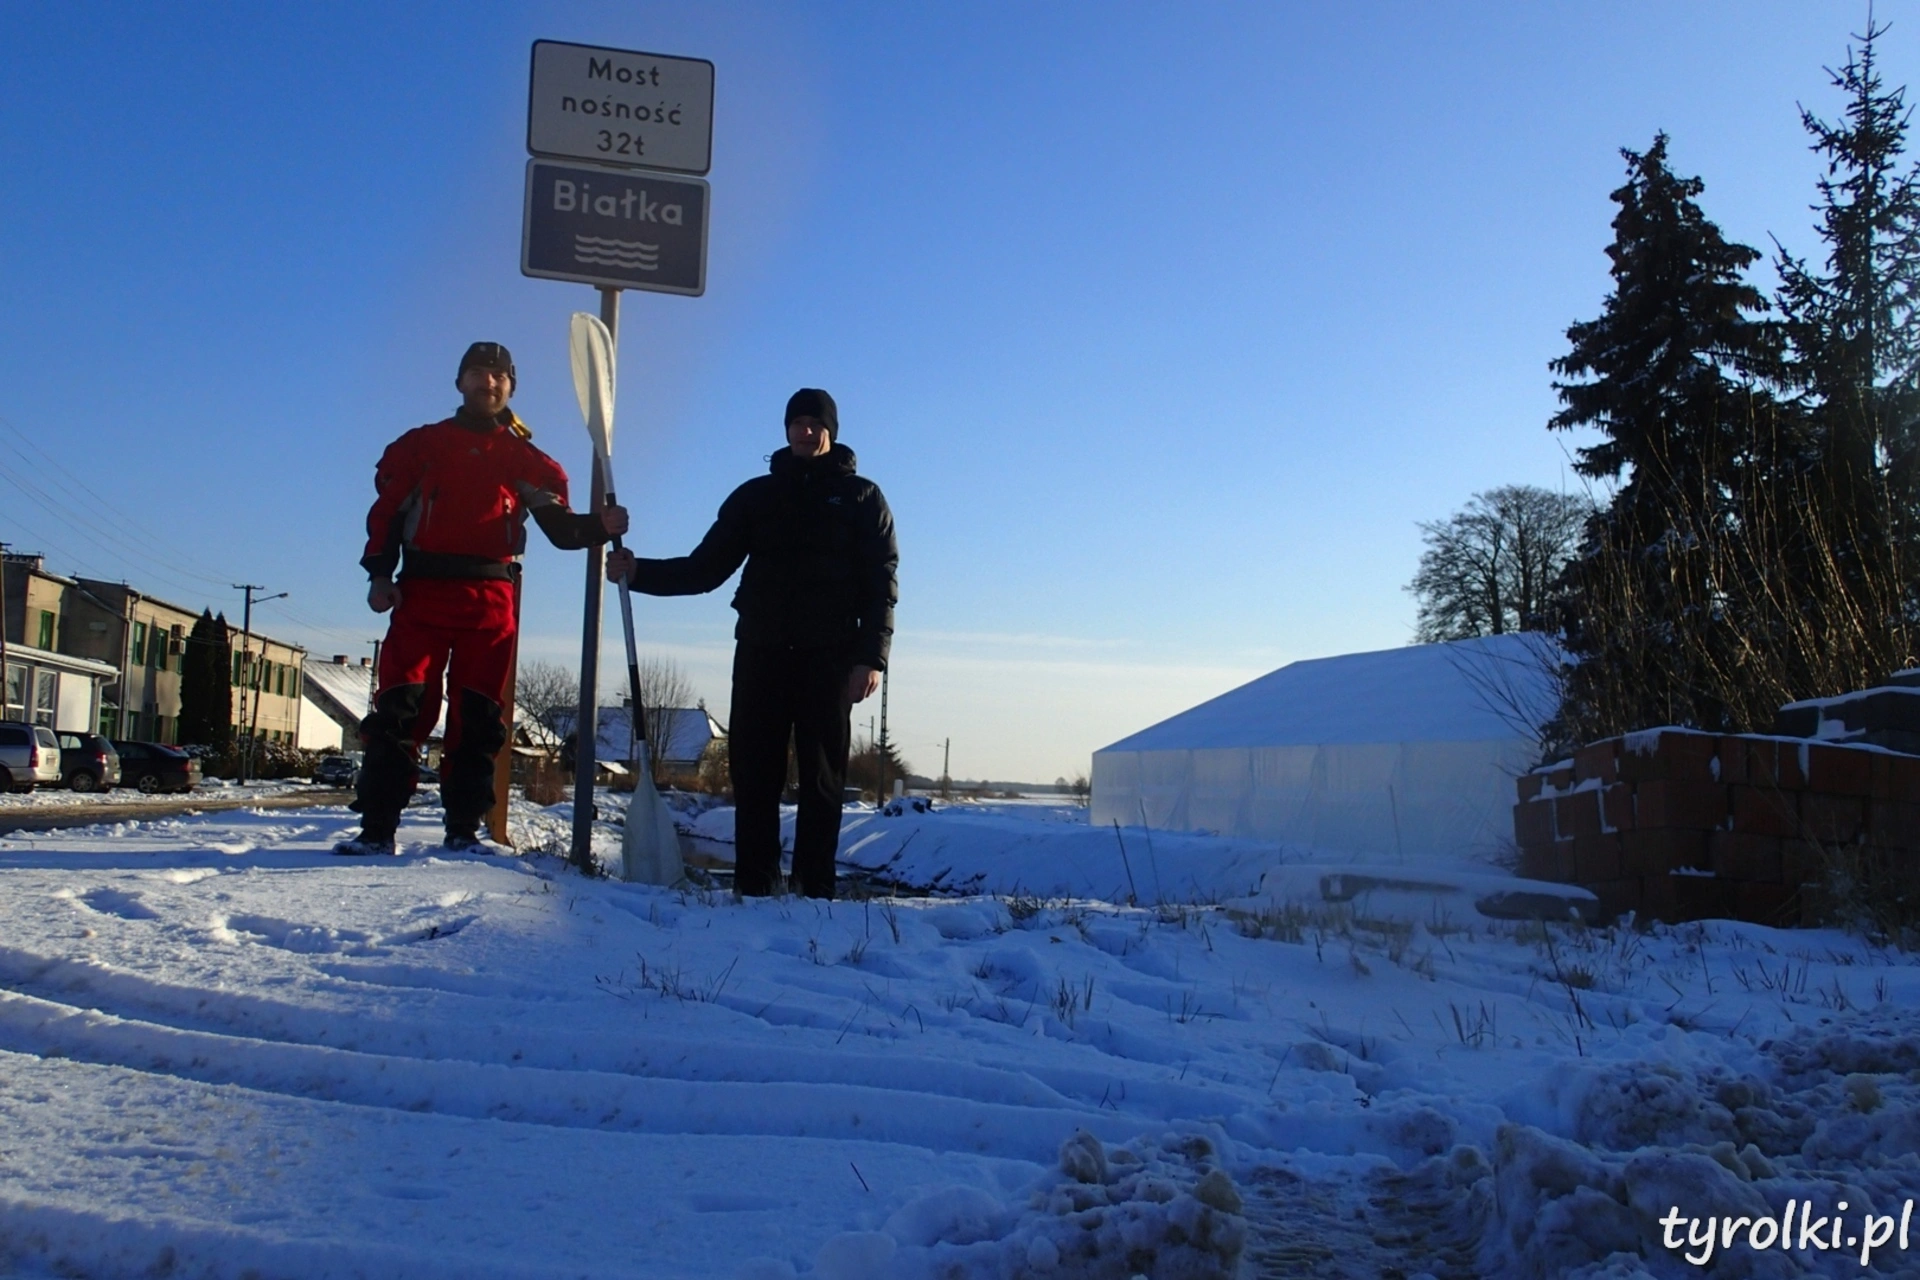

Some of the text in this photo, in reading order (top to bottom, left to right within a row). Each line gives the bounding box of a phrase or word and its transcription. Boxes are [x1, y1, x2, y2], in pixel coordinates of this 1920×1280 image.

[588, 56, 660, 87] Most
[561, 94, 682, 126] nośność
[596, 129, 645, 156] 32t
[553, 179, 683, 226] Białka
